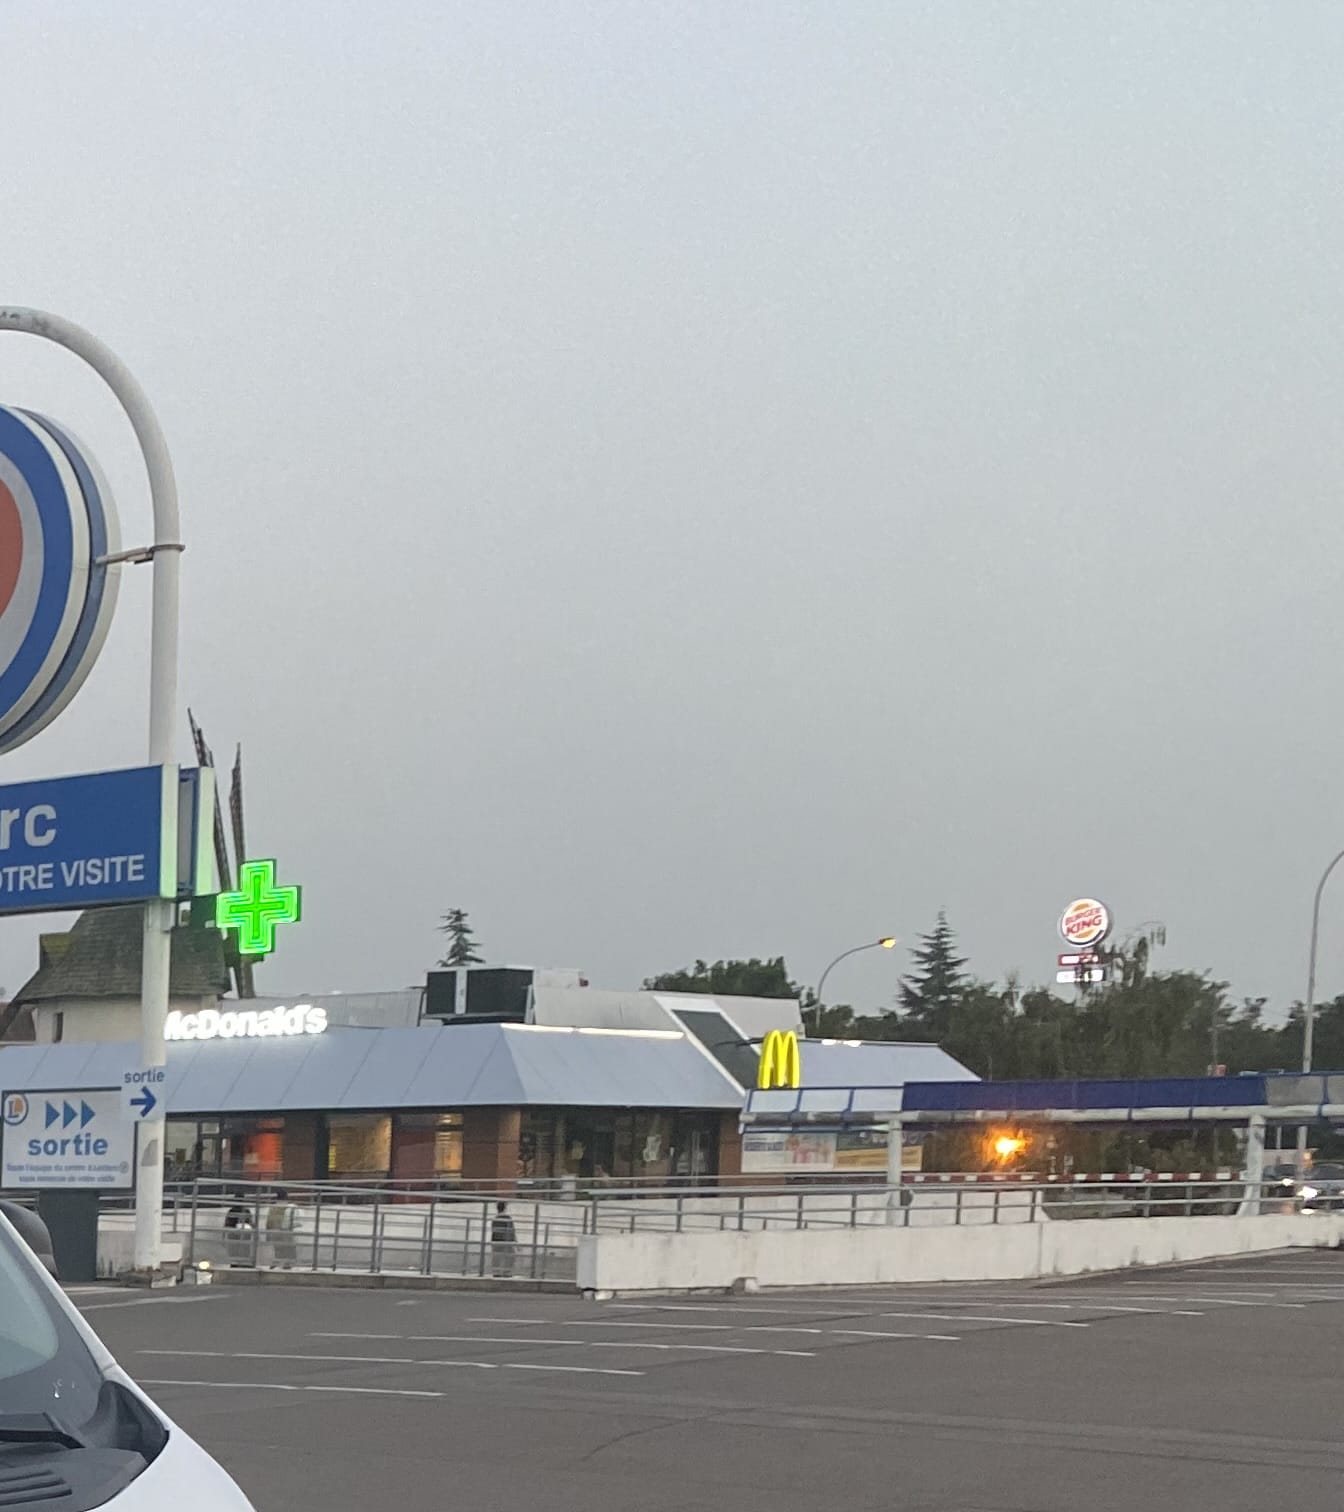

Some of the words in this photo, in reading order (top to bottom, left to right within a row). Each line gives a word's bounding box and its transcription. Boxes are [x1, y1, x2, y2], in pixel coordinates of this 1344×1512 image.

[61, 853, 145, 886] VISITE
[1066, 914, 1102, 936] KING
[124, 1069, 164, 1083] sortie
[28, 1133, 109, 1156] sortie
